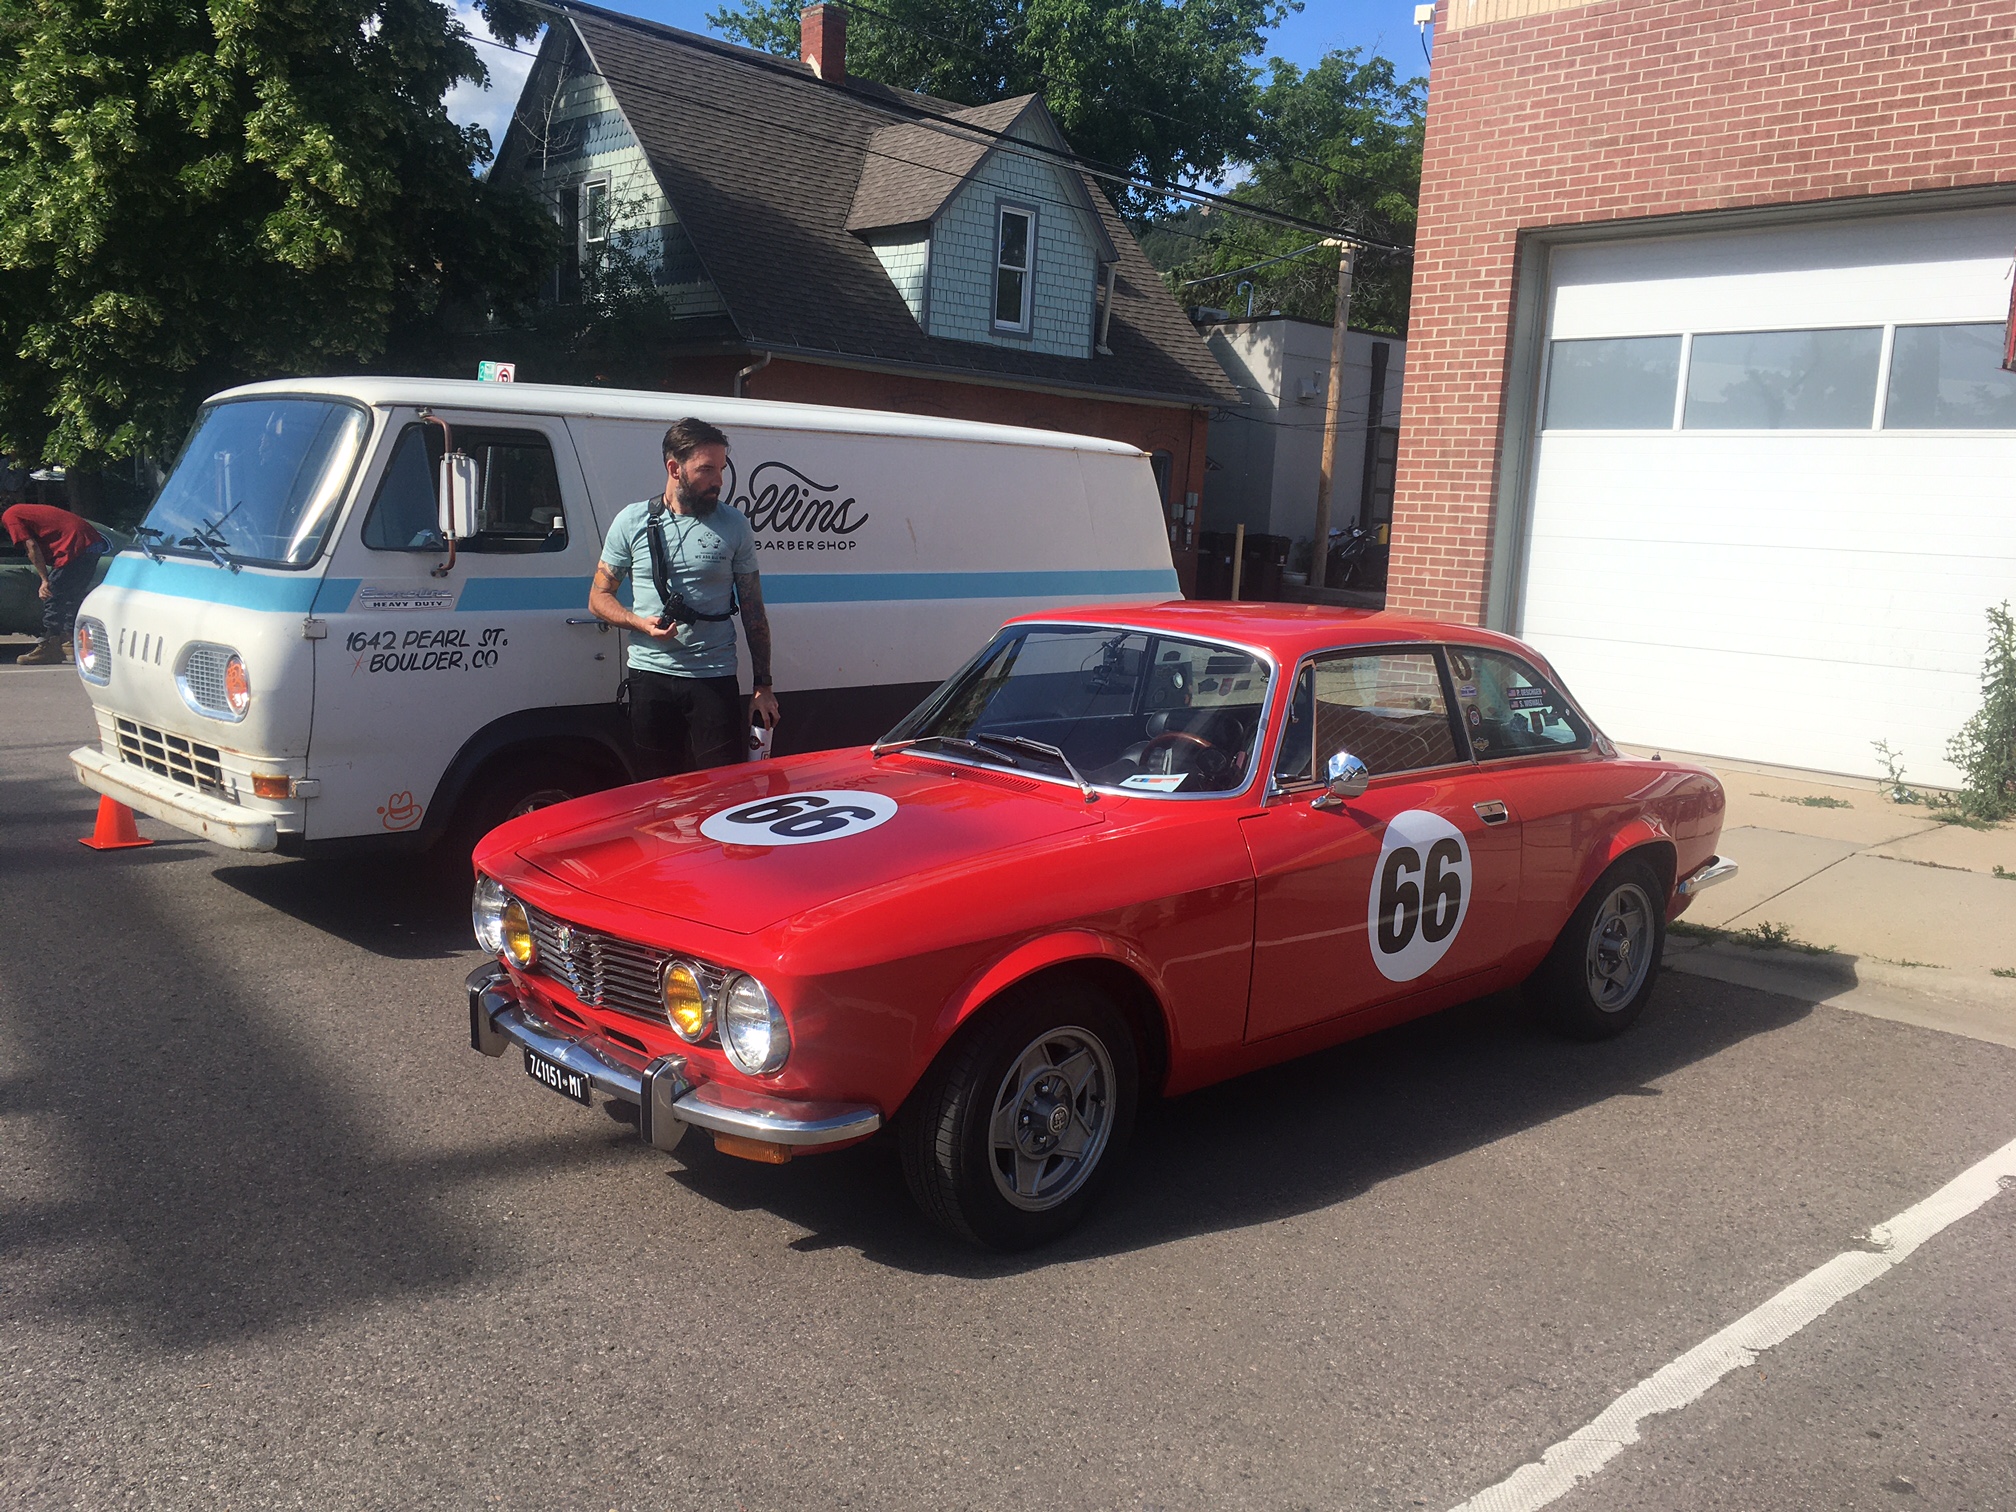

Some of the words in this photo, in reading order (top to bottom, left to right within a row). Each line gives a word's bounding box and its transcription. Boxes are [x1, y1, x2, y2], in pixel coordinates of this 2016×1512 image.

[755, 540, 857, 550] BARBERSHOP
[346, 630, 396, 652] 1642
[402, 629, 470, 649] PEARL
[478, 628, 508, 648] ST.
[369, 651, 469, 673] BOULDER,
[472, 649, 499, 669] CO
[726, 796, 876, 838] 66
[1378, 838, 1462, 954] 66
